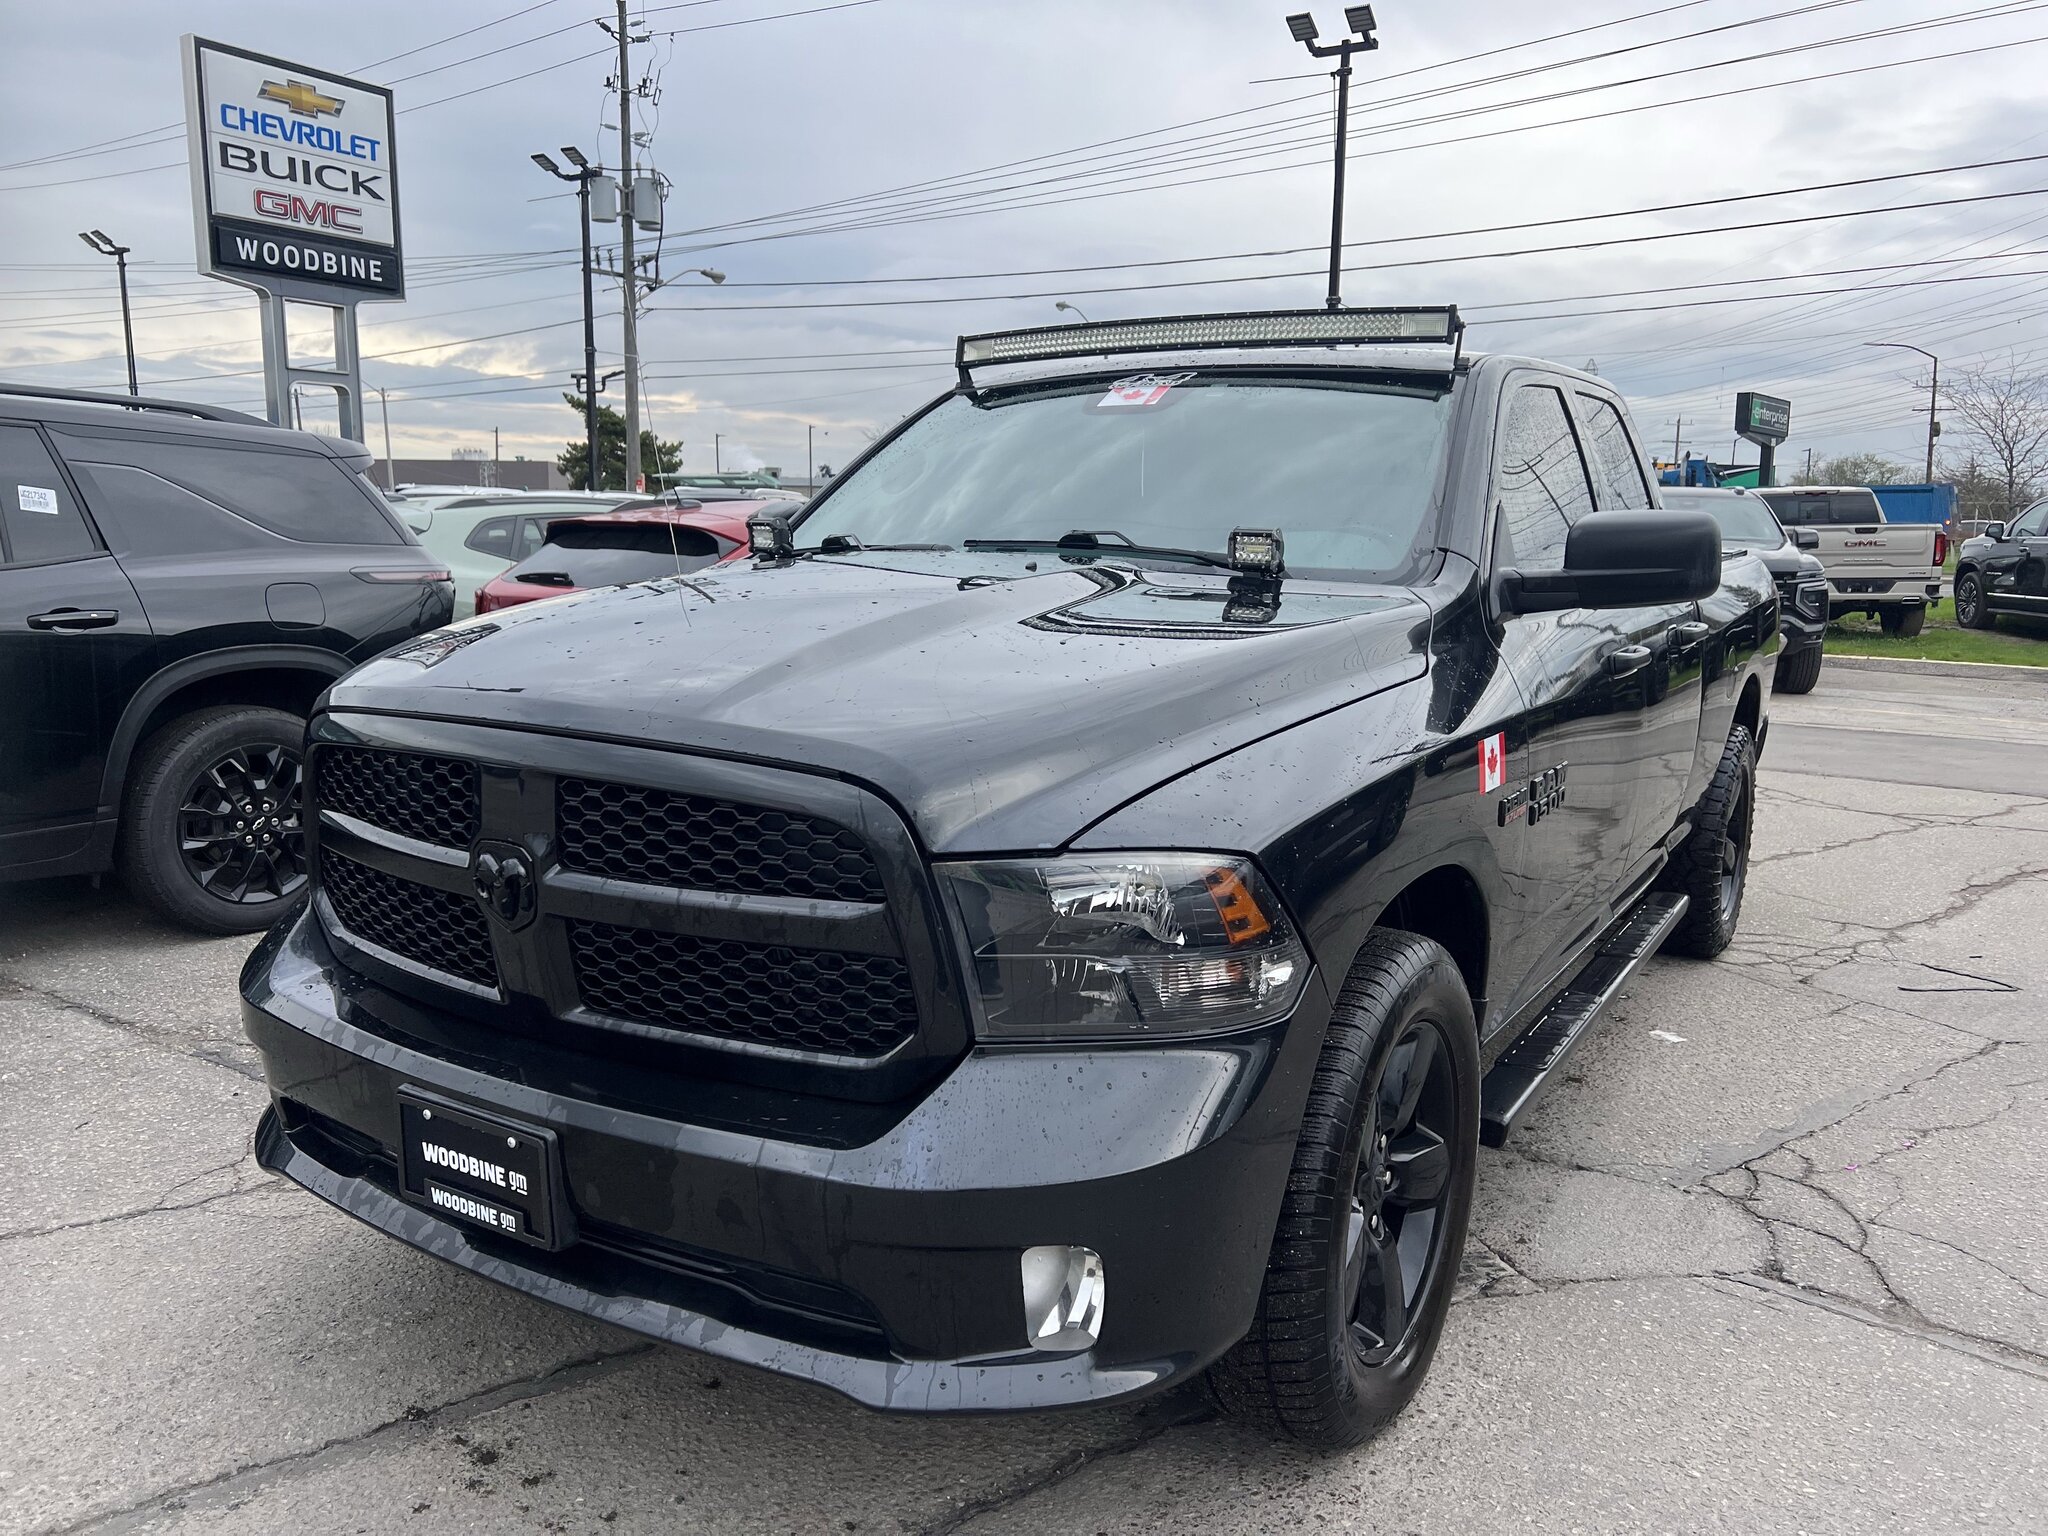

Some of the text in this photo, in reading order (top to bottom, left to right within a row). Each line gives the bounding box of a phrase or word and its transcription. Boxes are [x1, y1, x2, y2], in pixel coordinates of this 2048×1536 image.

[220, 103, 380, 161] CHEVROLET
[219, 141, 385, 201] BUICK
[253, 188, 363, 234] GMC
[235, 236, 383, 282] WOODBINE
[1754, 407, 1788, 424] enterprise
[1844, 538, 1887, 548] GMC
[1532, 760, 1568, 801] RAM
[1530, 786, 1566, 825] 1500
[422, 1141, 506, 1187] WOODBINE
[431, 1187, 498, 1225] WOODBINE
